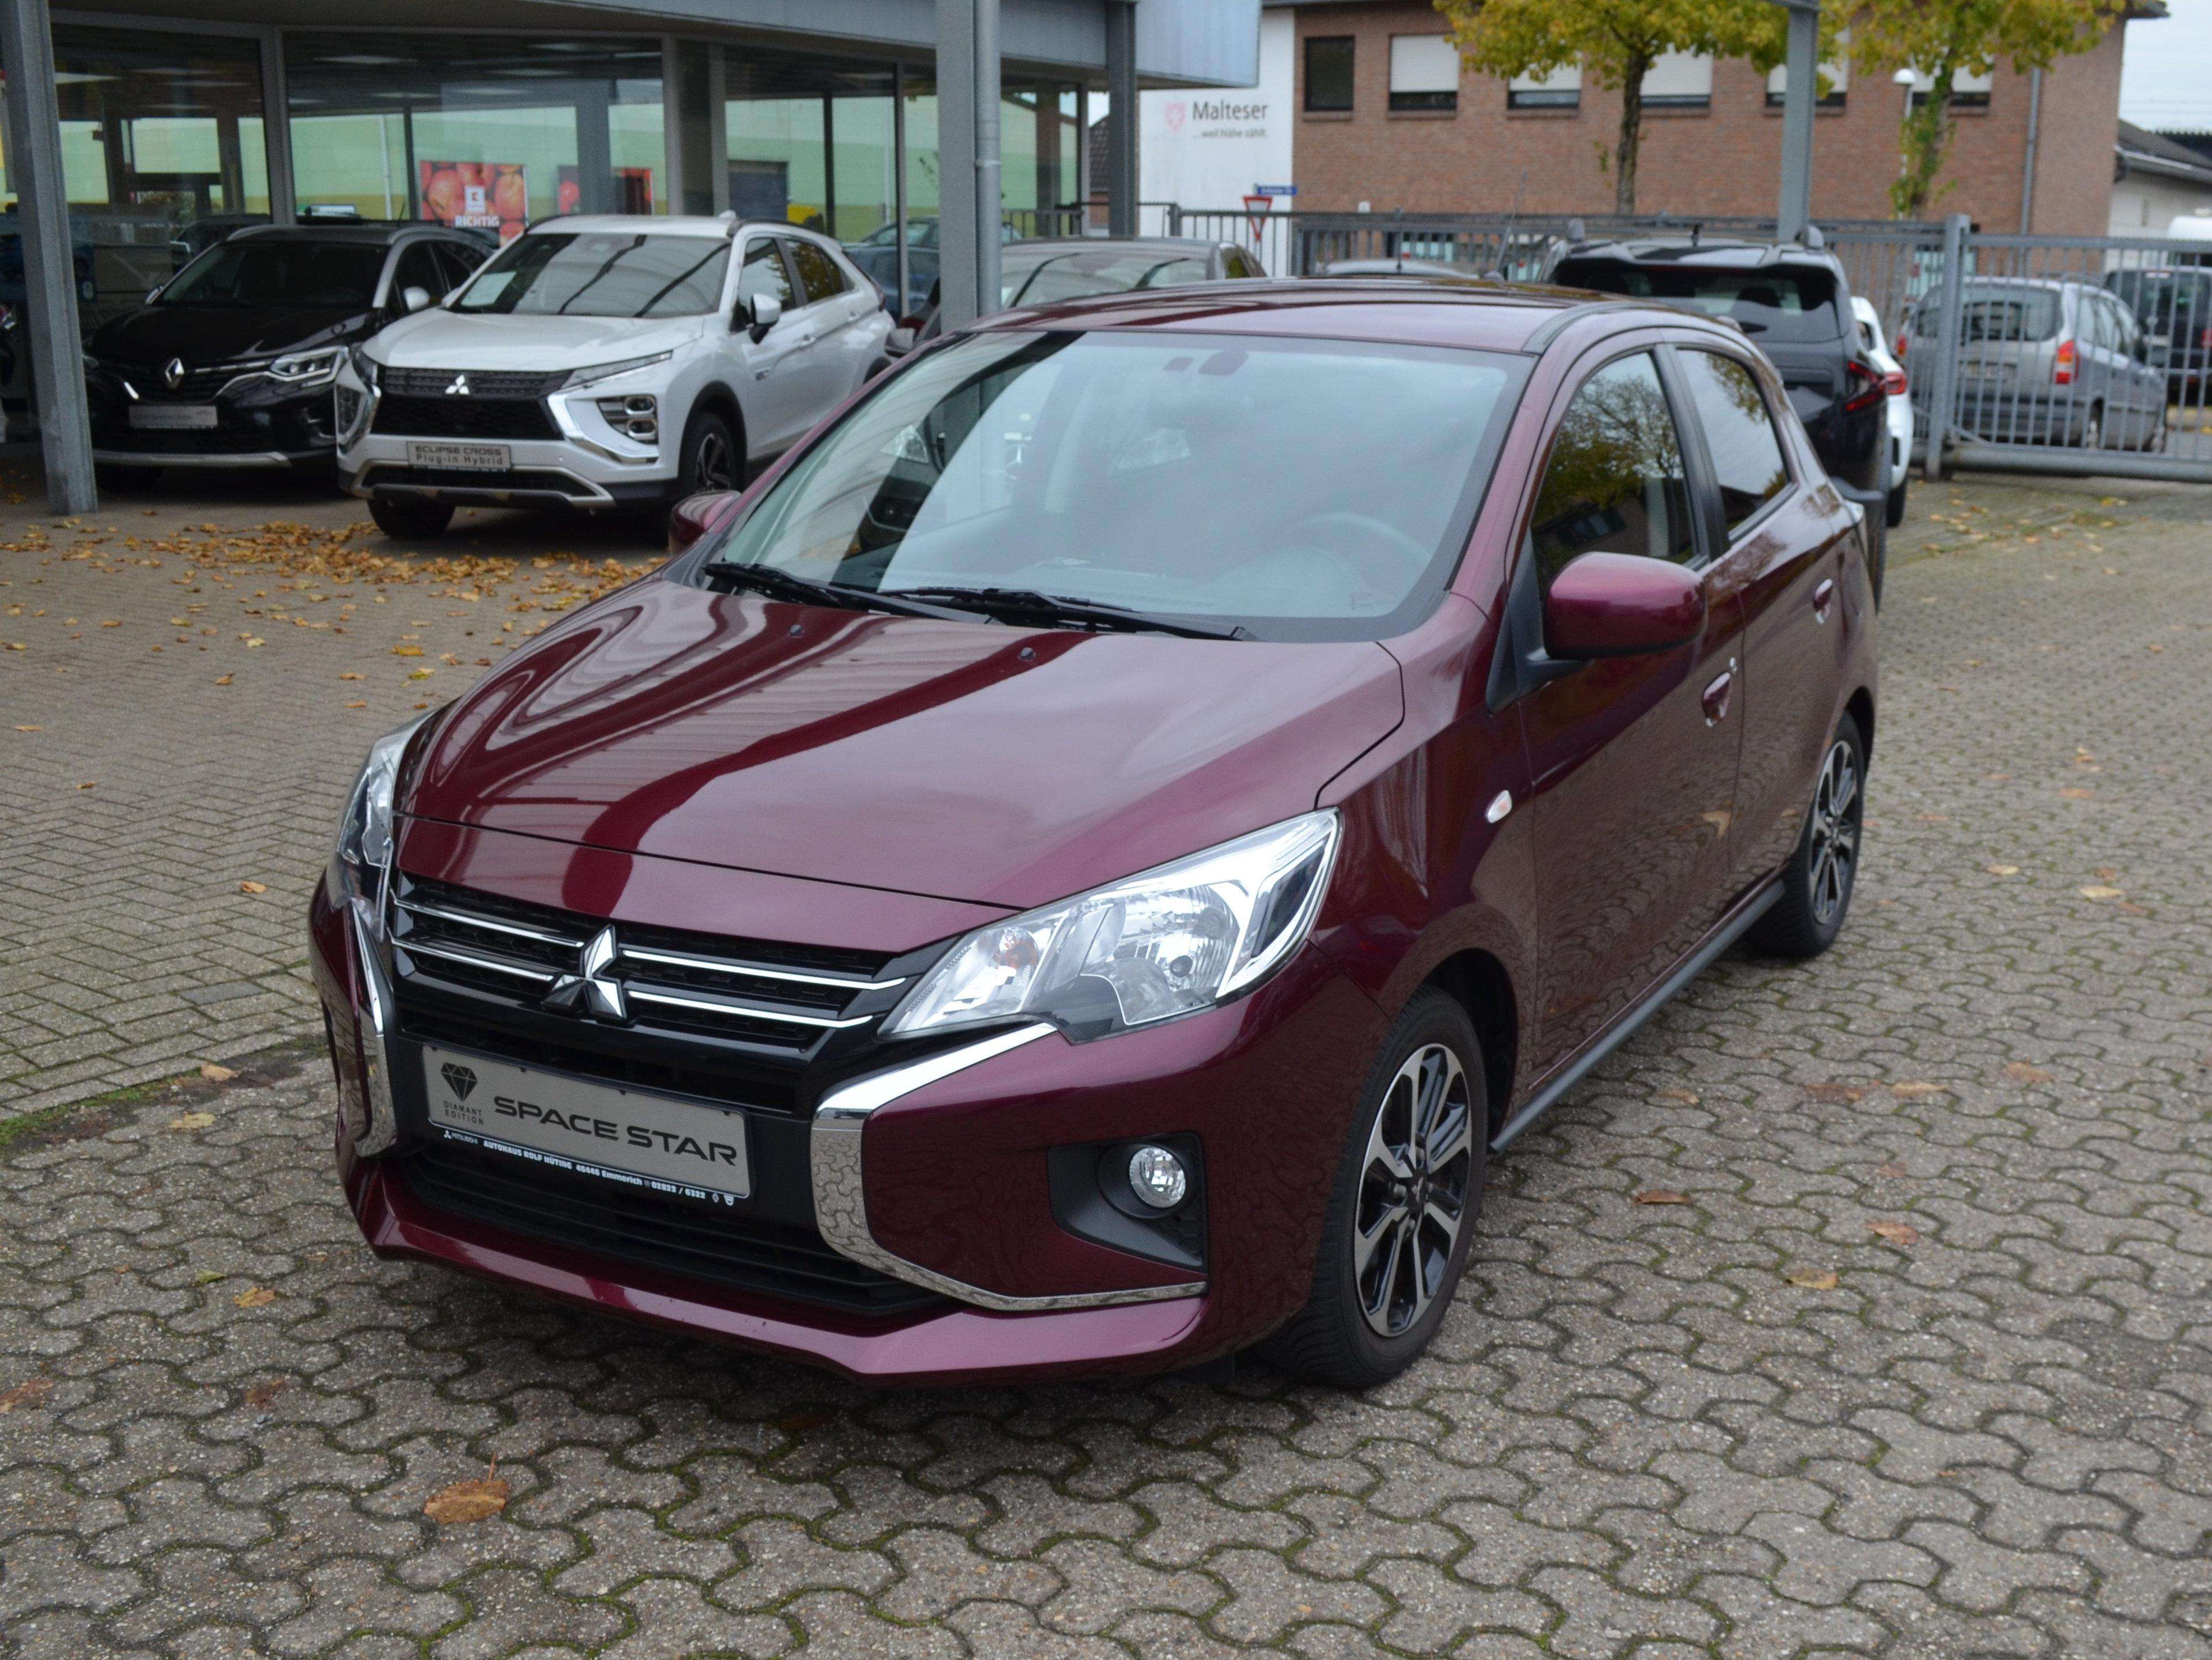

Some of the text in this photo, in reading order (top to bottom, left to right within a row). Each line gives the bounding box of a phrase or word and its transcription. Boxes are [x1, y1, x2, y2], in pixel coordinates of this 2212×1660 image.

[1192, 99, 1268, 120] Malteser
[415, 445, 502, 455] ECLIPSE CROSS
[416, 453, 503, 466] Plug-in Hybrid
[443, 1100, 482, 1116] DIAMANT
[444, 1109, 484, 1125] EDITION
[494, 1095, 737, 1166] SPACE STAR
[483, 1139, 522, 1157] AUTOHAUS
[523, 1150, 543, 1161] ROLF
[602, 1169, 643, 1186] Emmerich
